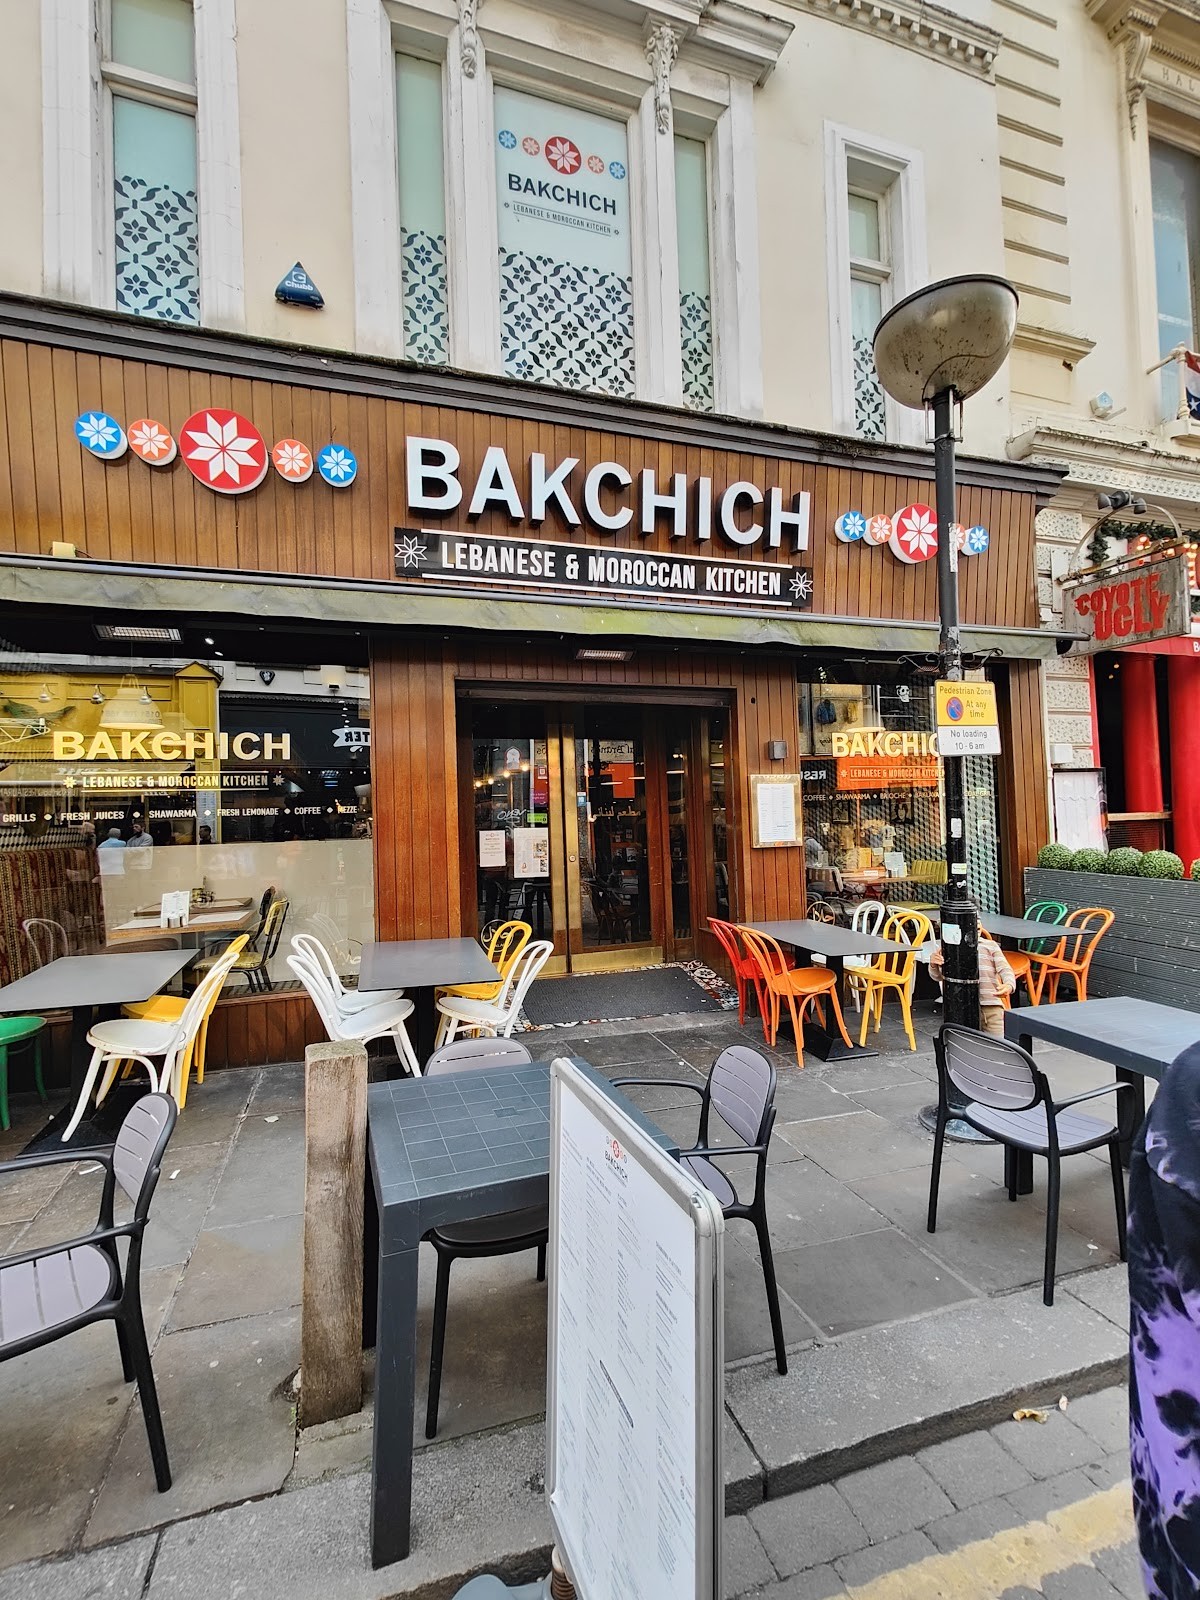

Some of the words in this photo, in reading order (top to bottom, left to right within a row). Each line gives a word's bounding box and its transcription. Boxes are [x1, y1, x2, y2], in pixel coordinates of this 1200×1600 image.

[508, 173, 617, 215] BAKCHICH
[513, 203, 544, 218] LEBANESE
[546, 211, 551, 219] &
[552, 213, 585, 227] MOROCCAN
[586, 221, 612, 234] KITCHEN
[285, 280, 314, 291] Chubb
[406, 435, 812, 552] BAKCHICH
[441, 541, 556, 578] LEBANESE
[565, 554, 580, 580] &
[587, 556, 696, 590] MOROCCAN
[705, 567, 782, 596] KITCHEN
[1074, 572, 1161, 616] COYOTE
[1093, 595, 1171, 641] UGLY
[939, 685, 975, 695] Pedestrian
[976, 687, 992, 696] Zone
[965, 700, 974, 708] At
[975, 701, 987, 710] any
[969, 710, 985, 718] time
[950, 730, 961, 738] No
[962, 729, 988, 739] loading
[53, 731, 291, 761] BAKCHICH
[831, 732, 940, 758] BAKCHIC
[82, 776, 143, 788] LEBANESE
[146, 776, 155, 788] &
[158, 775, 219, 788] MOROCCAN
[222, 775, 268, 787] KITCHEN
[850, 769, 882, 778] LEBANESE
[882, 769, 887, 778] &
[888, 769, 922, 778] MOROCCAN
[835, 792, 871, 800] SHAWARMA
[2, 813, 37, 823] GRILLS
[60, 811, 91, 821] FRESH
[93, 811, 125, 820] JUICES
[149, 808, 197, 819] SHAWARMA
[217, 808, 240, 817] FRESH
[242, 807, 279, 816] LEMONADE
[294, 806, 322, 815] COFFEE
